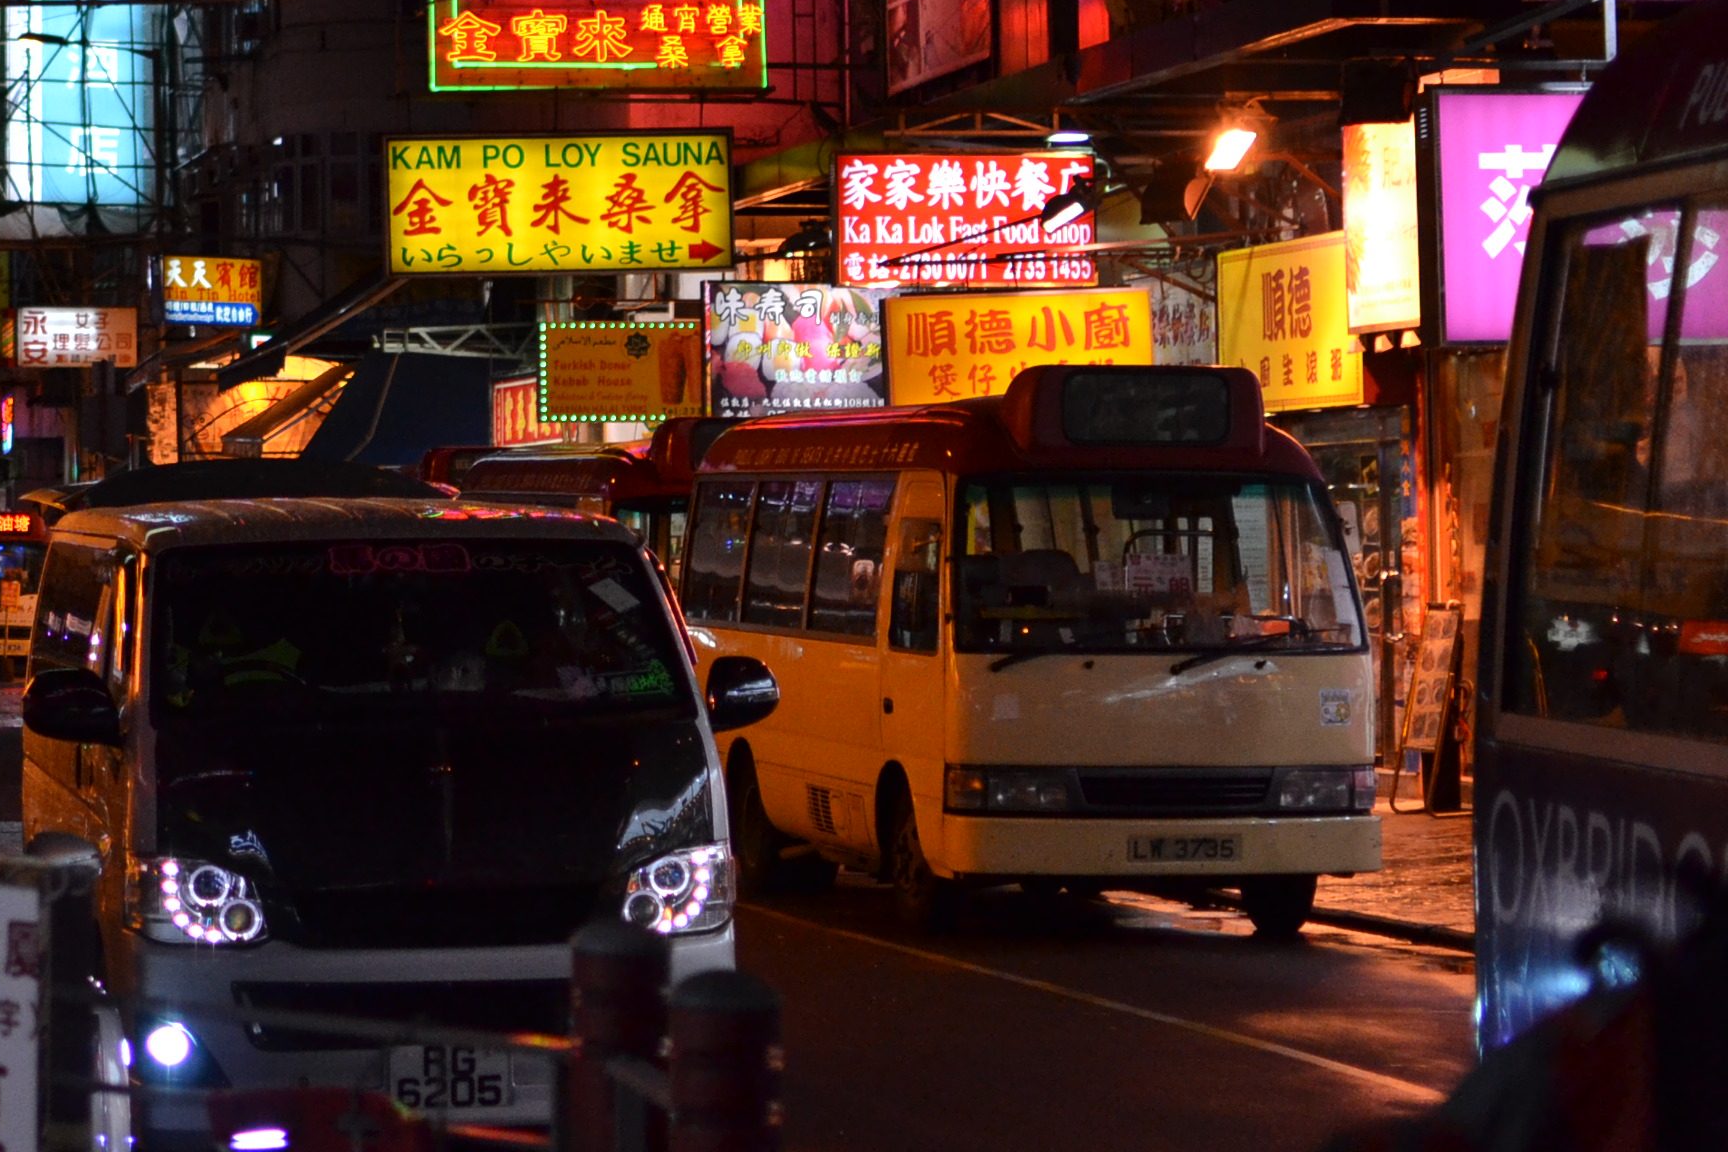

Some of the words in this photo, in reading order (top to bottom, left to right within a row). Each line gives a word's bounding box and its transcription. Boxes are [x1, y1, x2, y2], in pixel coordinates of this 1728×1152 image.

[391, 145, 462, 170] KAM
[482, 144, 526, 168] PO
[544, 143, 603, 168] LOY
[621, 142, 726, 167] SAUNA
[843, 215, 871, 244] Ka
[875, 215, 904, 244] Ka
[907, 215, 945, 244] Lok
[948, 216, 989, 245] Fast
[992, 216, 1040, 245] Food
[1261, 265, 1313, 342] 順德
[397, 1074, 502, 1108] 6205
